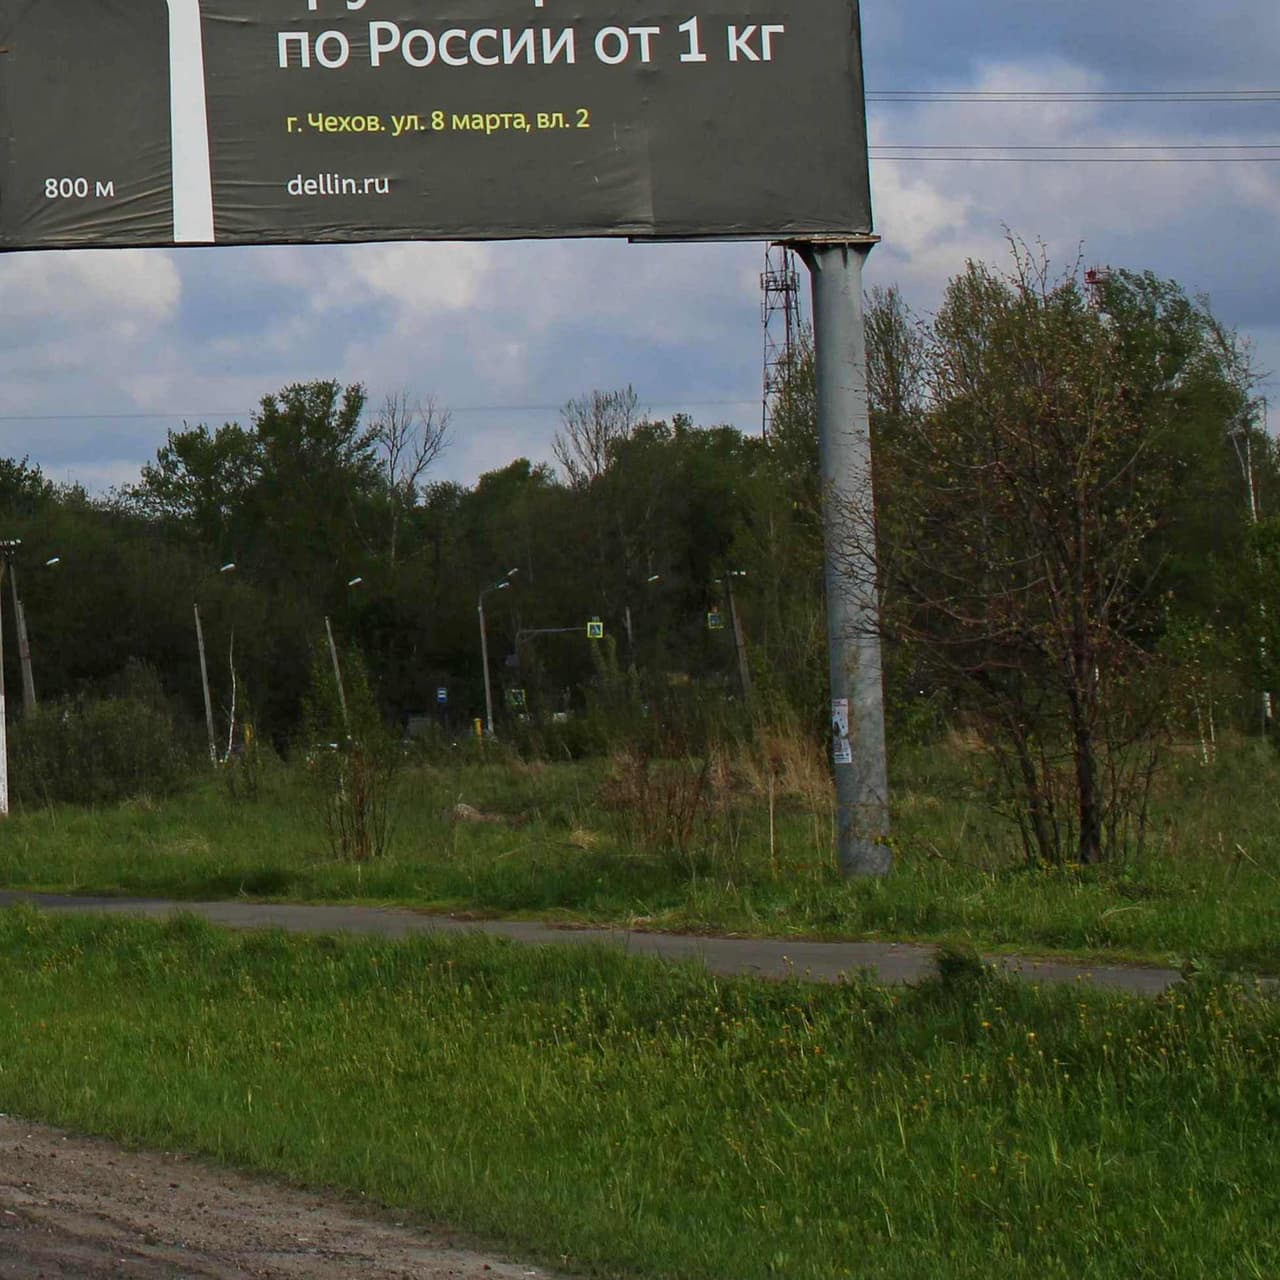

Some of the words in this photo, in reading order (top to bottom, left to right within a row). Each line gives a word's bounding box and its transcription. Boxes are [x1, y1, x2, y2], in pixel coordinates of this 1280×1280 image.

[277, 30, 353, 69] по
[368, 20, 576, 68] России
[594, 26, 661, 65] от
[678, 15, 707, 63] 1
[727, 24, 786, 62] кг
[286, 116, 303, 133] г.
[307, 112, 386, 133] Чехов.
[390, 114, 426, 137] ул.
[430, 110, 445, 131] 8
[451, 113, 531, 135] марта,
[536, 112, 570, 129] вл.
[575, 108, 591, 128] 2
[44, 177, 89, 199] 800
[94, 181, 115, 197] м
[286, 173, 390, 196] dellin.ru
